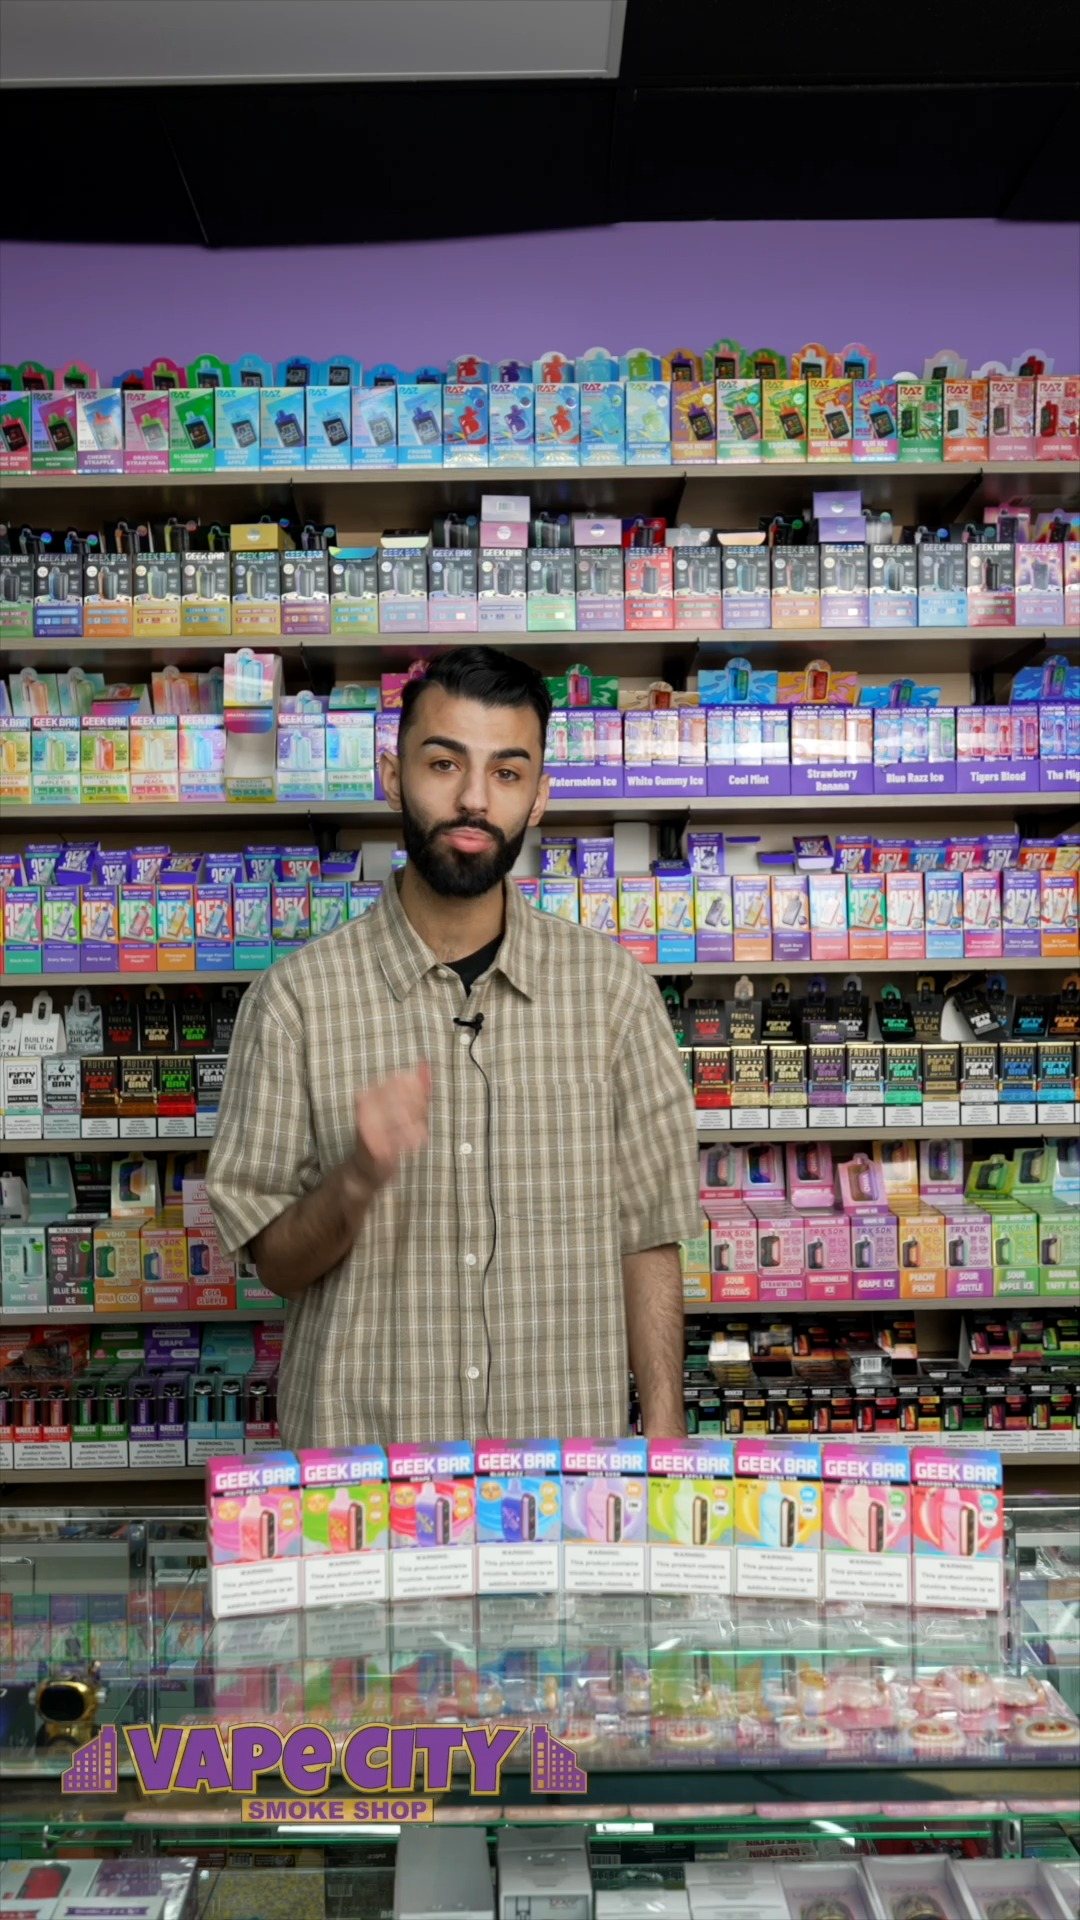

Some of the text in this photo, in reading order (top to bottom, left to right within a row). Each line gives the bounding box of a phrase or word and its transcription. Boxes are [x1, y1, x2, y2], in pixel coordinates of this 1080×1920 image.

[900, 386, 922, 395] RAZ
[946, 386, 969, 394] RAZ
[992, 383, 1015, 392] RAZ
[1040, 383, 1063, 391] RAZ
[34, 717, 78, 726] GEEK BAR
[82, 717, 127, 726] GEEK BAR
[130, 716, 176, 725] GEEK BAR
[278, 715, 323, 724] GEEK BAR
[807, 768, 858, 779] Strawberry
[886, 772, 944, 784] Blue Razz Ice
[970, 771, 1026, 784] Tigers Blood
[1046, 770, 1063, 780] The
[549, 776, 617, 787] Watermelon Ice
[627, 775, 703, 787] White Gummy Ice
[728, 774, 769, 785] Cool Mint
[816, 781, 849, 791] Banana
[909, 1273, 936, 1281] PEACHY
[959, 1272, 979, 1280] SOUR
[1007, 1271, 1025, 1279] SOUR
[1048, 1270, 1077, 1278] BANANA
[725, 1276, 745, 1284] SOUR
[857, 1279, 895, 1288] GRAPE ICE
[912, 1284, 935, 1292] PEACH
[956, 1283, 983, 1292] SKITTLE
[1000, 1282, 1034, 1291] APPLE ICE
[1046, 1282, 1066, 1290] TAFFY
[722, 1288, 751, 1296] STRAWS
[392, 1456, 471, 1475] GEEK BAR
[478, 1453, 557, 1470] GEEK BAR
[565, 1453, 643, 1470] GEEK BAR
[652, 1455, 729, 1472] GEEK BAR
[738, 1456, 817, 1474] GEEK BAR
[304, 1461, 384, 1482] GEEK BAR
[825, 1461, 906, 1478] GEEK BAR
[915, 1462, 997, 1482] GEEK BAR
[215, 1467, 296, 1489] GEEK BAR
